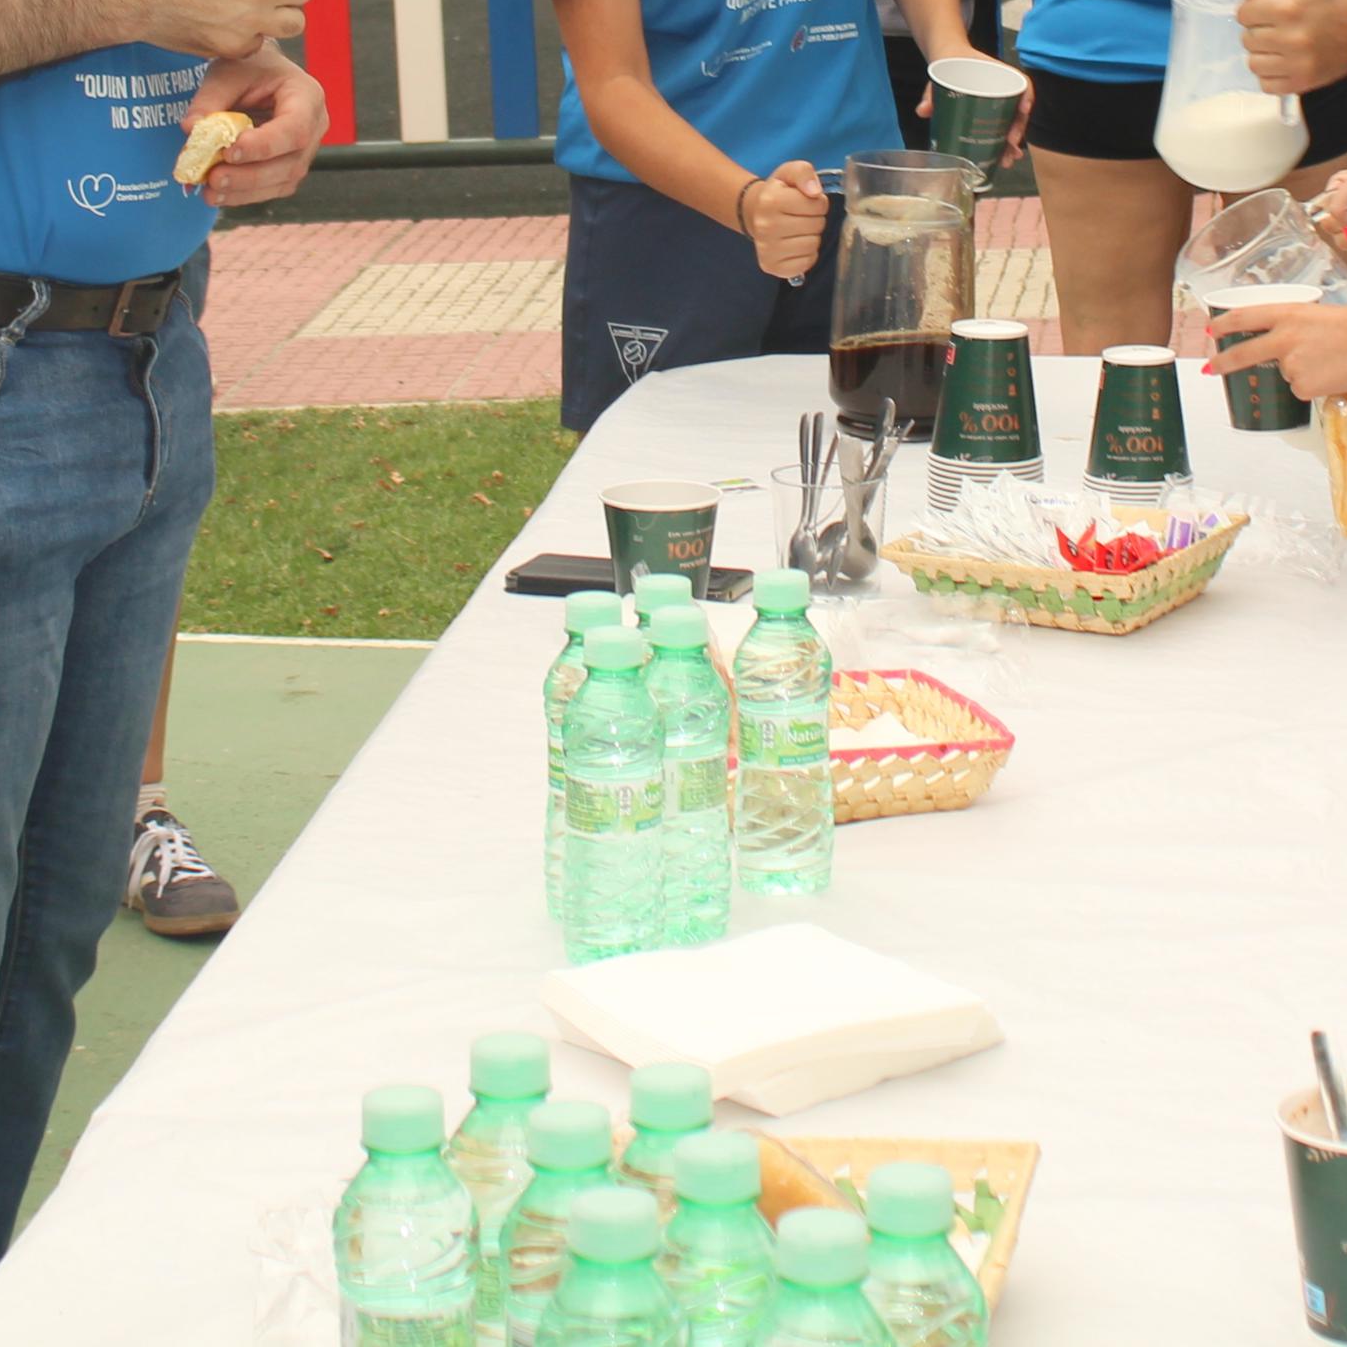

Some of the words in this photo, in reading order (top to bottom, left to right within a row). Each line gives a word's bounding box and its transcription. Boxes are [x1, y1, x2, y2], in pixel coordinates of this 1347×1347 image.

[146, 72, 172, 98] VIVE
[171, 67, 196, 93] PARA
[111, 105, 129, 130] NO
[981, 413, 1021, 432] 100
[1126, 436, 1165, 454] 100
[668, 539, 705, 561] 100
